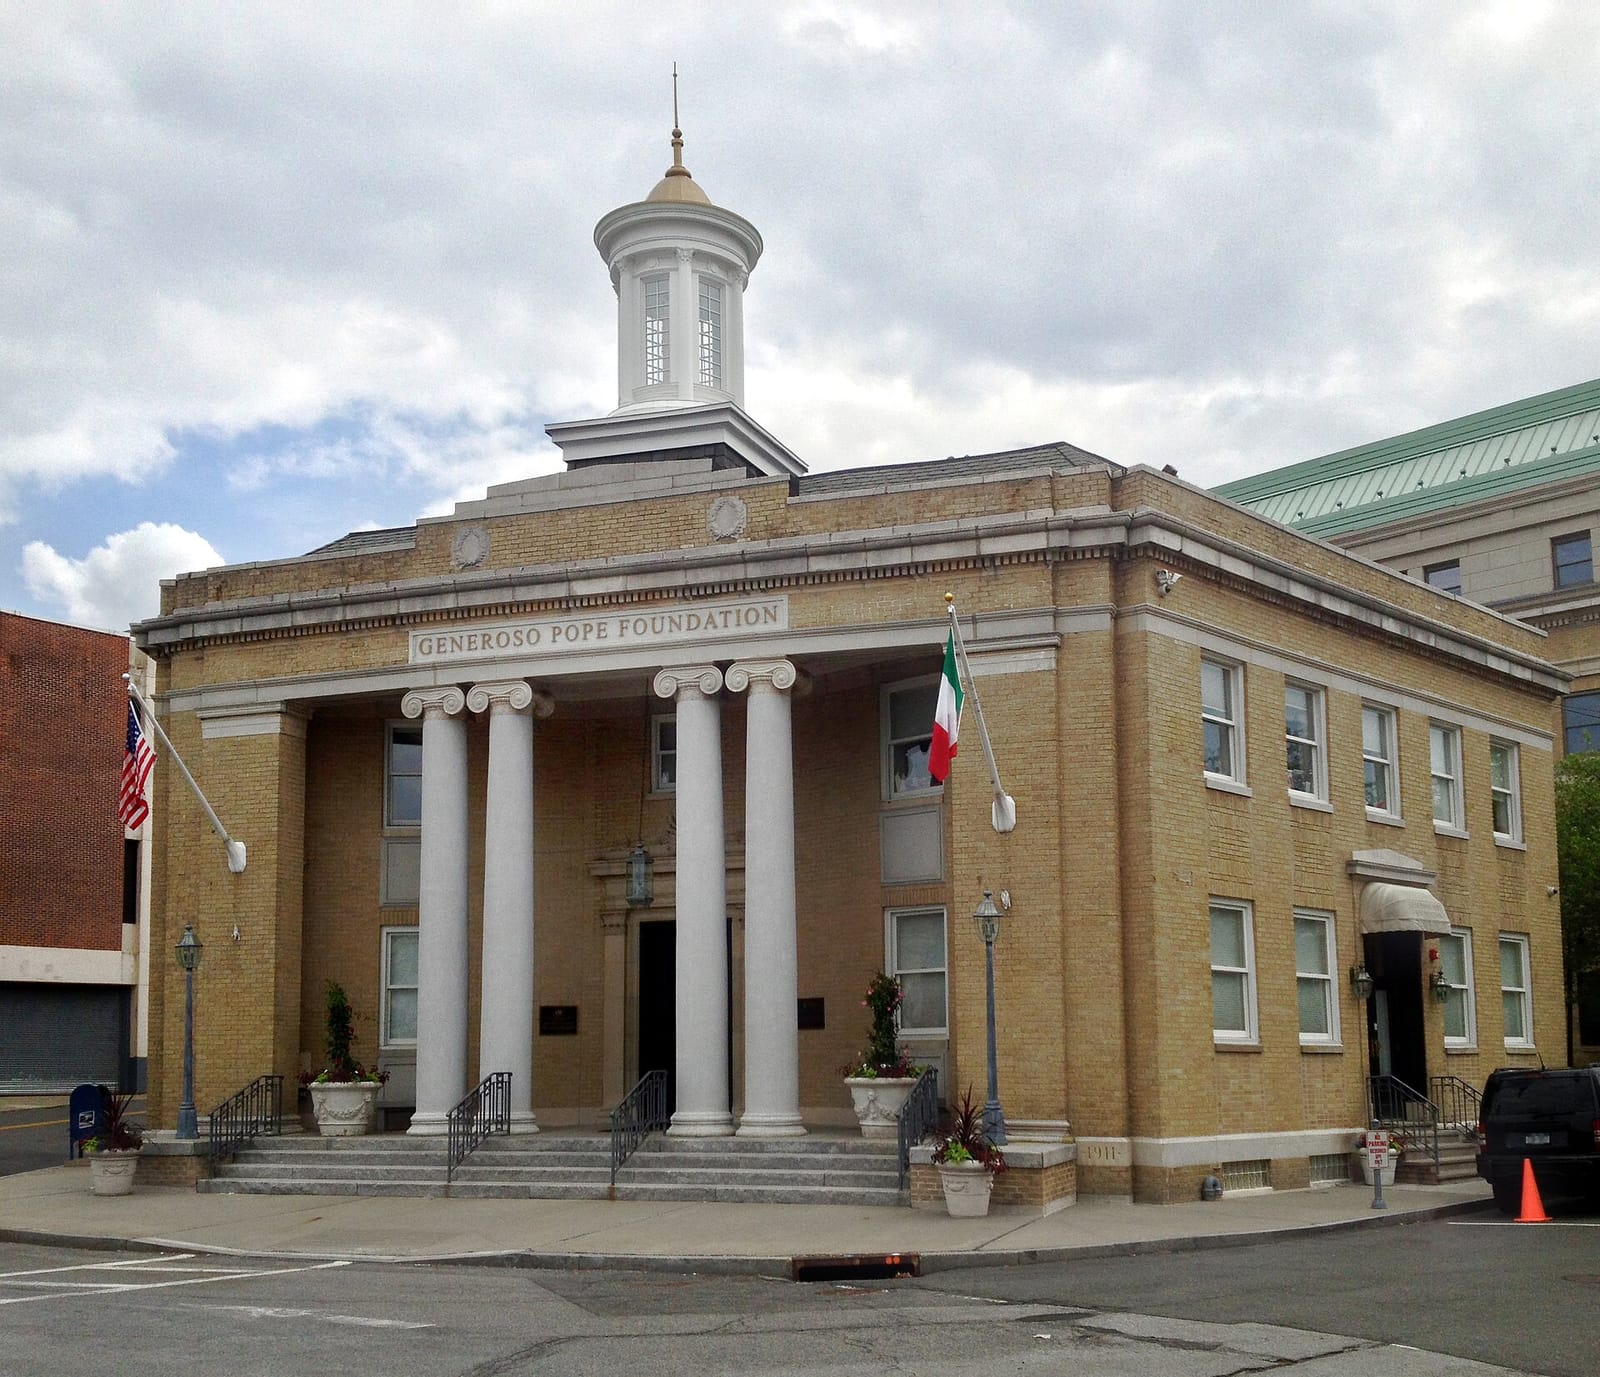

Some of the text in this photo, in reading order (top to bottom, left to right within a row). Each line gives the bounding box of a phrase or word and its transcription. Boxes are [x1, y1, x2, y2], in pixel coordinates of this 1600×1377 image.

[418, 605, 779, 656] GENEROSO POPE FOUNDATION
